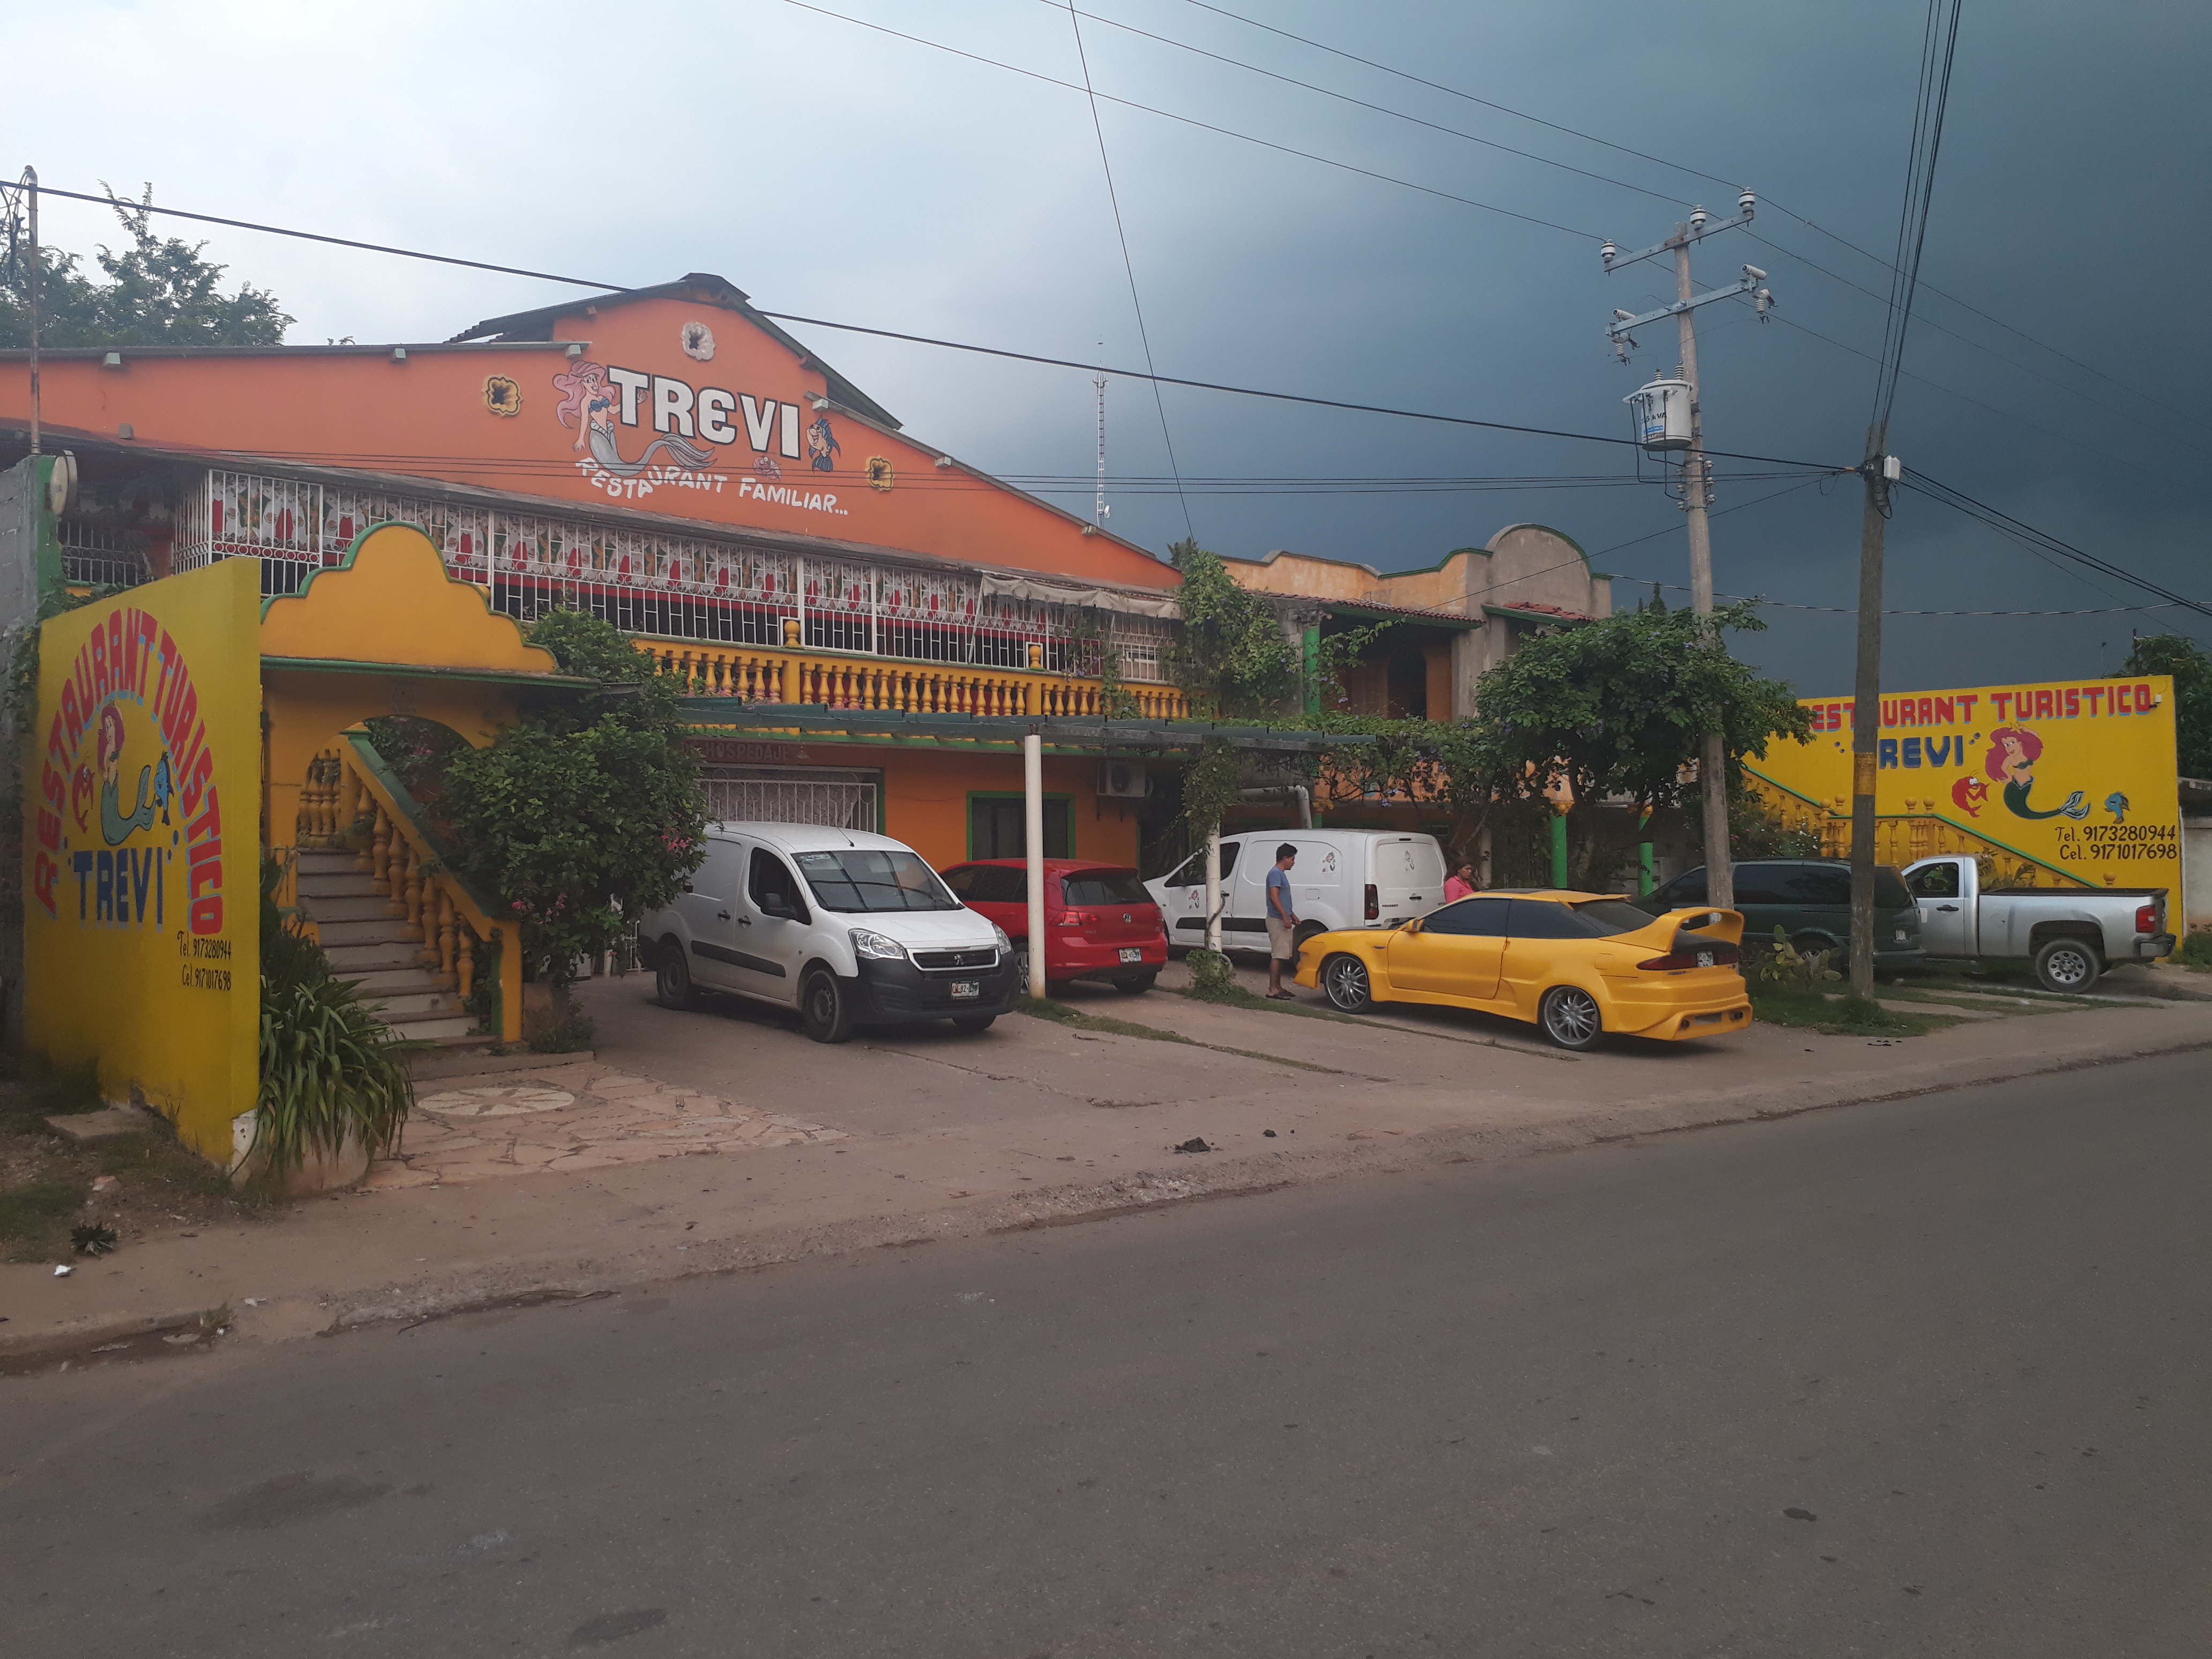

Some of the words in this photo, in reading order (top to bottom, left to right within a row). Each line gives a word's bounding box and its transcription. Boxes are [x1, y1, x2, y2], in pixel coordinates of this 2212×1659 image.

[607, 365, 801, 460] TREVI
[575, 457, 728, 499] RESTAURANT
[739, 477, 848, 515] FAMILIAR...
[1795, 694, 1978, 732] ESTURANT
[1990, 683, 2151, 722] TURISTICO
[34, 607, 158, 920] RESTAURANT
[152, 629, 223, 935] TURISTICO
[1852, 735, 1963, 769] REVI
[2054, 826, 2080, 842] Tel.
[2083, 825, 2176, 841] 9173280944
[2059, 844, 2087, 860] Cel.
[2090, 843, 2178, 860] 9171017698
[73, 846, 163, 930] TREVI
[193, 937, 231, 960] 9173280944
[195, 967, 231, 992] 9171017698
